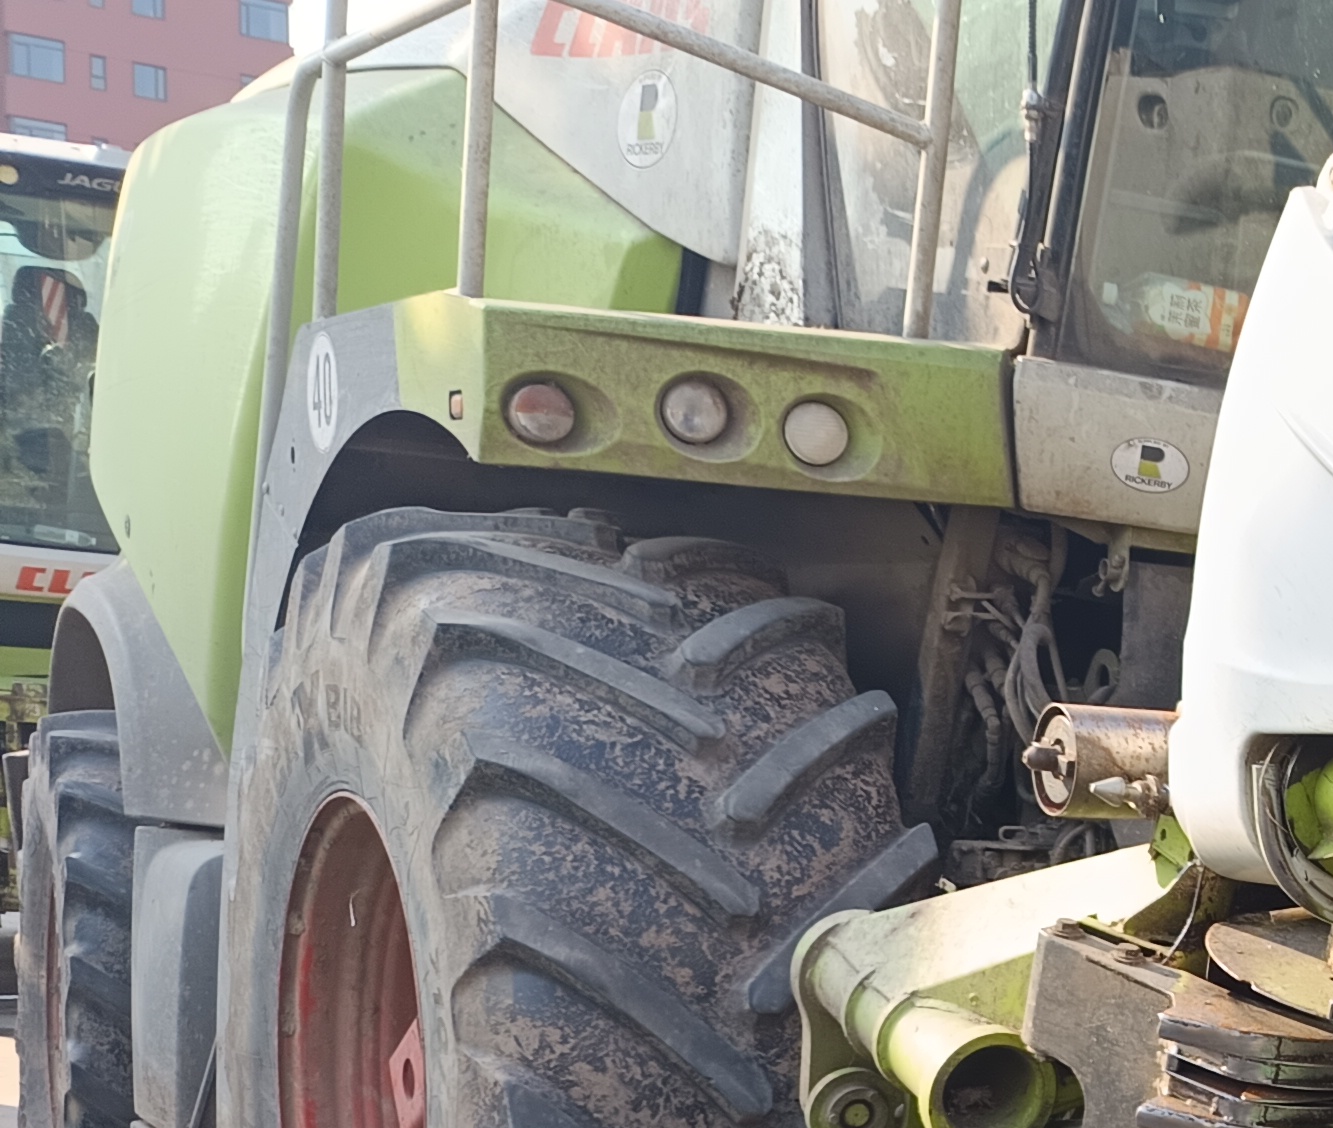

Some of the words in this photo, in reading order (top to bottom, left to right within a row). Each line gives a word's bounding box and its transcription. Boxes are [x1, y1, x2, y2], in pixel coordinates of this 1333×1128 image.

[313, 352, 333, 428] 40
[1124, 474, 1173, 489] RICKERBY
[15, 566, 97, 594] CL
